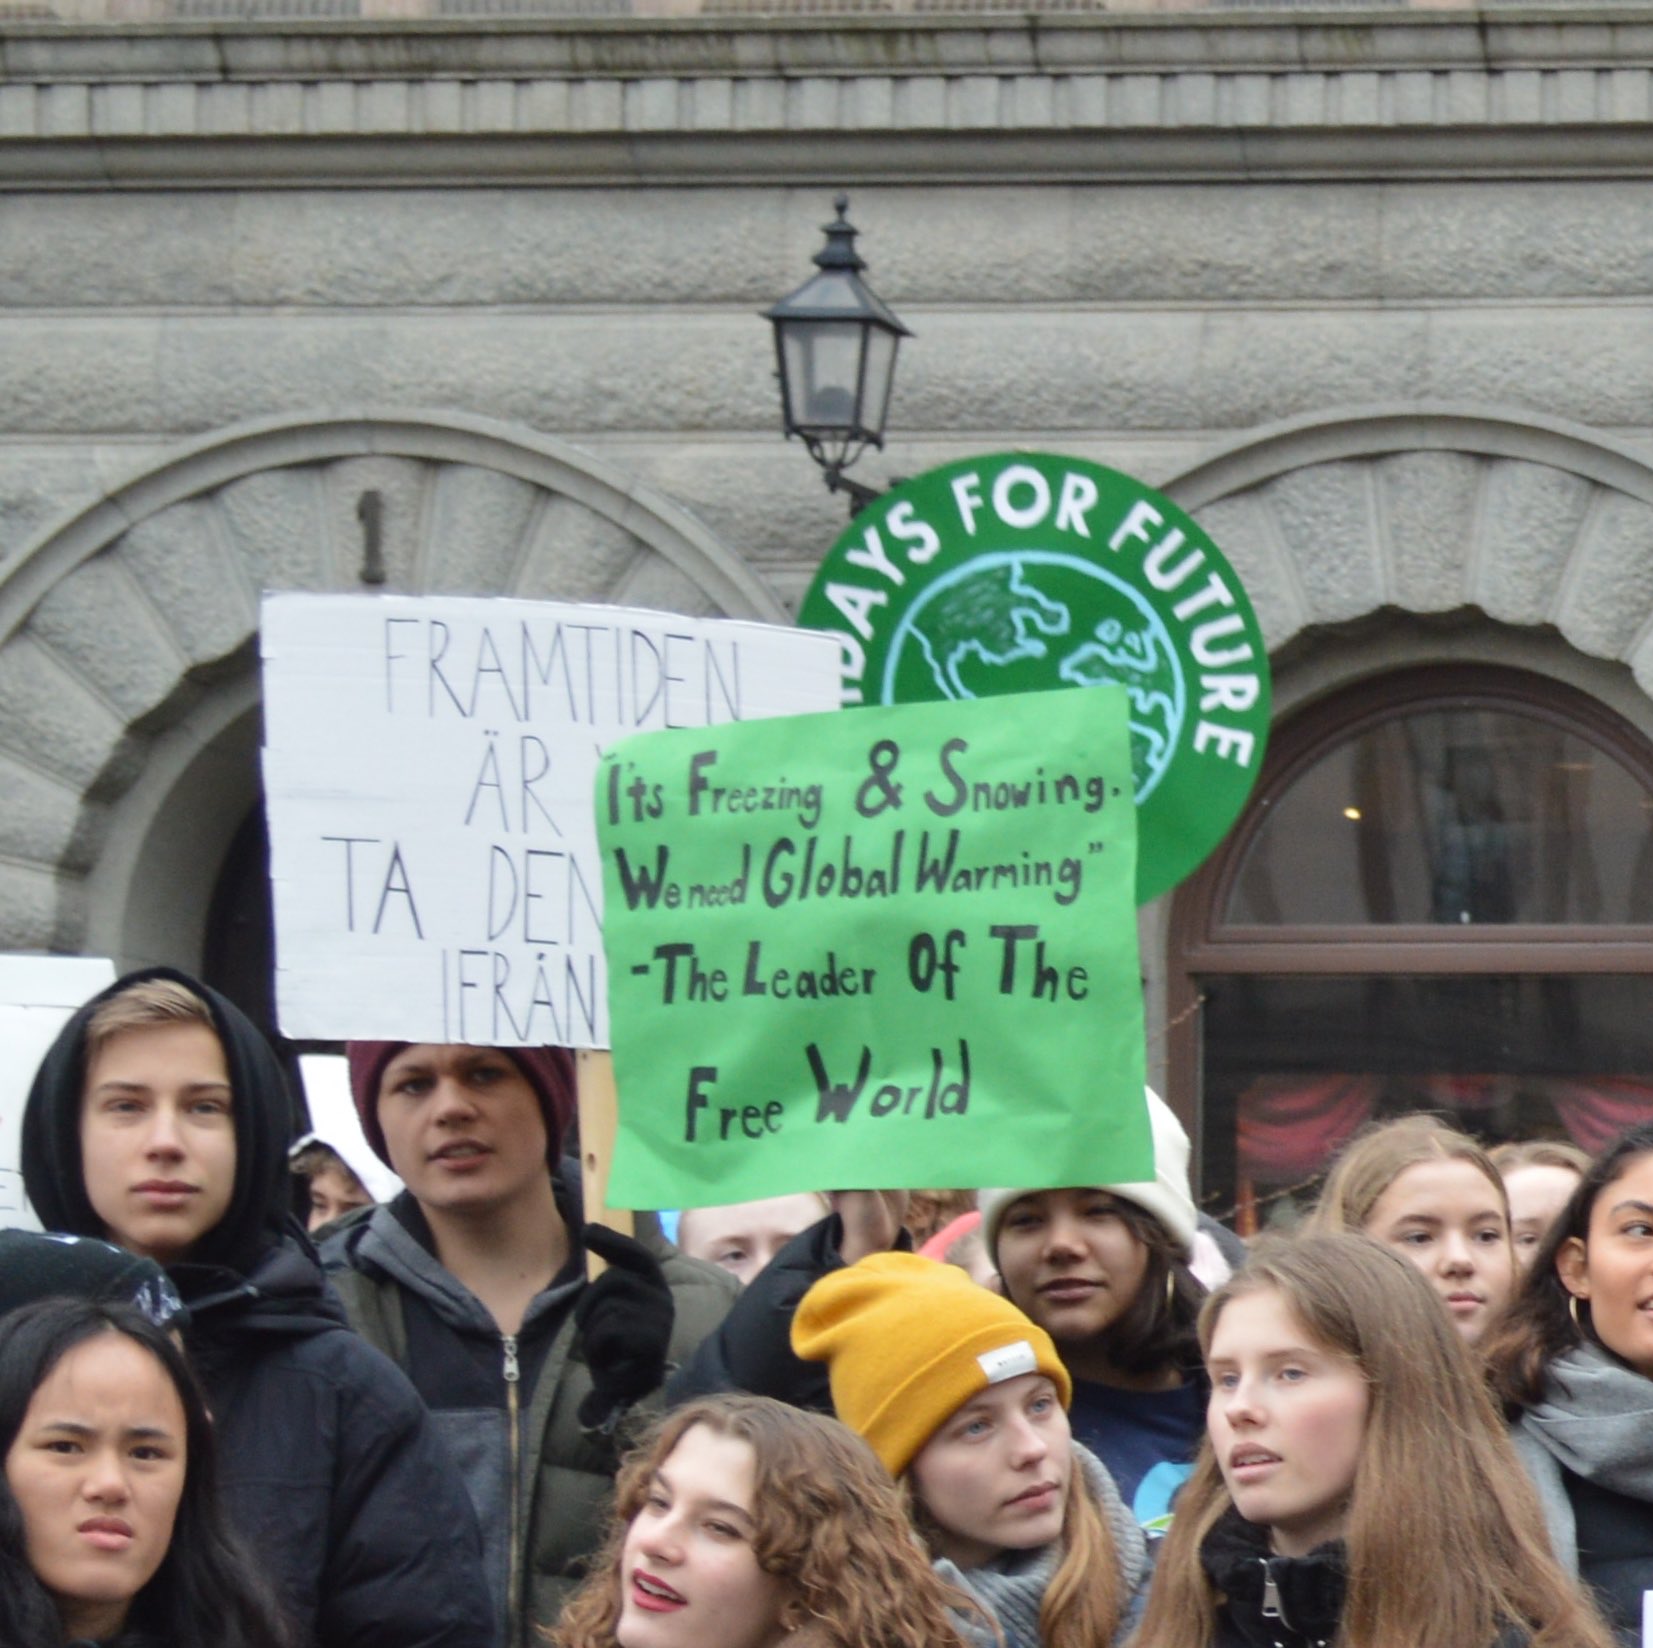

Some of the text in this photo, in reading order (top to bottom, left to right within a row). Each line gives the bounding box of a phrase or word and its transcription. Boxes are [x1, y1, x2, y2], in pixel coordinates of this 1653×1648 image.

[951, 464, 1099, 538] FOR
[1108, 500, 1260, 768] FUTURE
[385, 618, 742, 729] FRAMTIDEN
[464, 730, 563, 838] ÄR
[687, 750, 823, 829] Freezing
[853, 739, 904, 819] &
[320, 836, 603, 945] TA DEN
[613, 844, 681, 911] We
[688, 843, 751, 908] need
[762, 830, 905, 909] Global
[442, 949, 595, 1043] IFRÅN
[741, 940, 877, 1000] Leader
[907, 928, 966, 1001] Of
[988, 924, 1091, 1002] The
[683, 1038, 972, 1142] Free World
